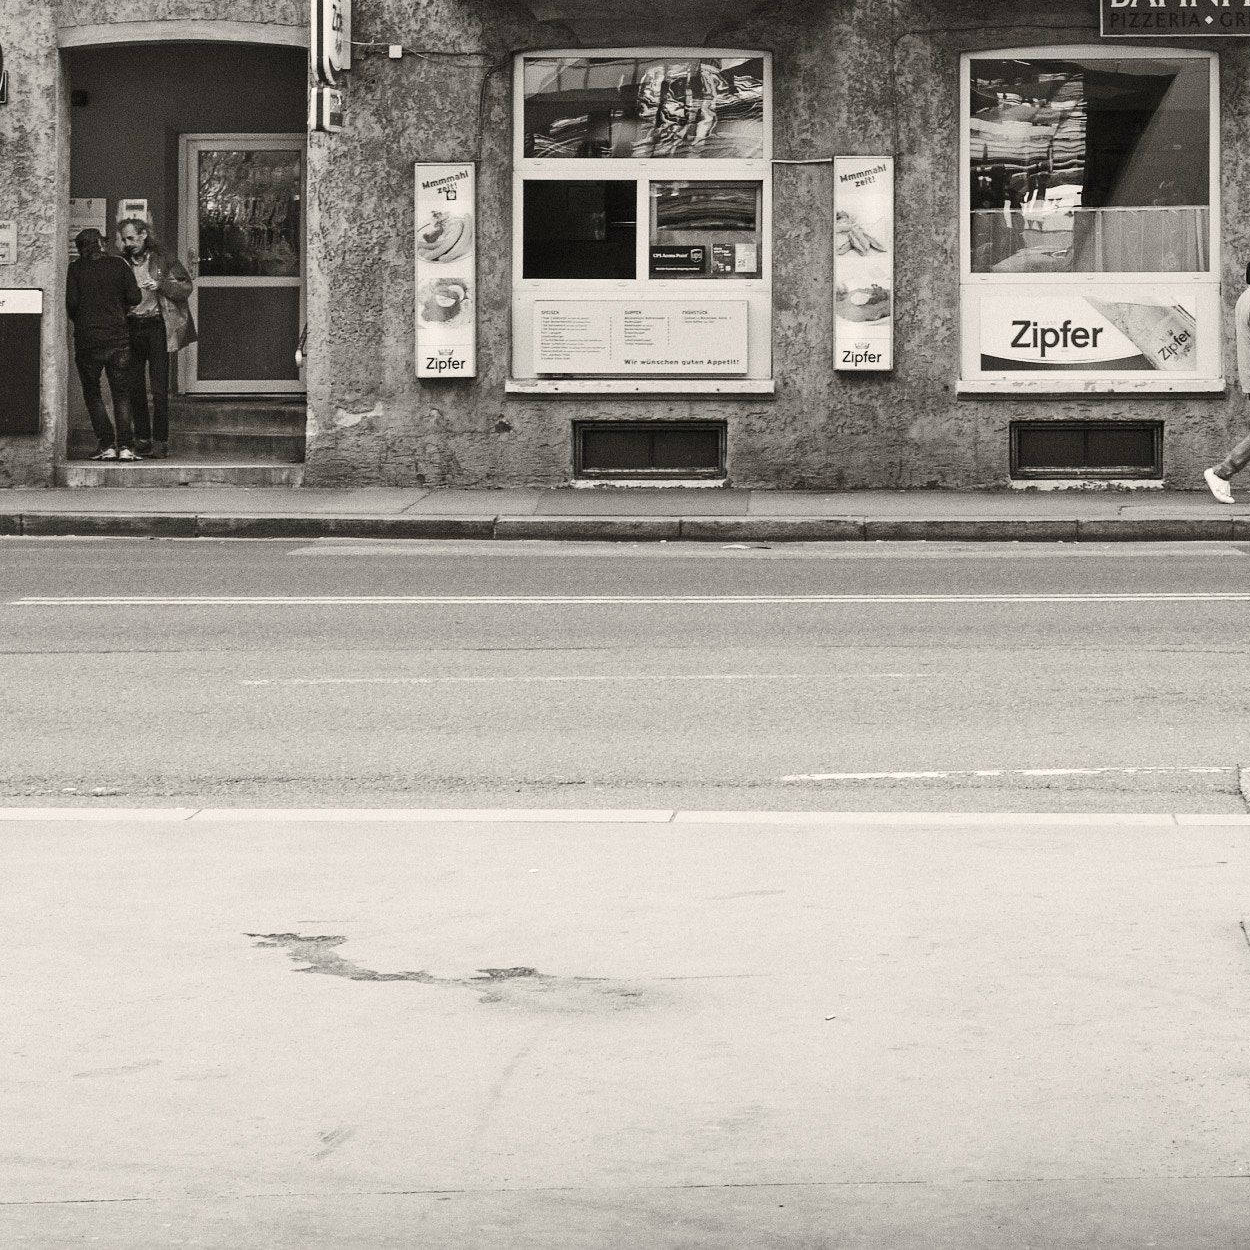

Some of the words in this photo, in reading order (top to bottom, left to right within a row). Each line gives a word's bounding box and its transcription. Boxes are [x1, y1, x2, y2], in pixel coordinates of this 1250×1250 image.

[1110, 12, 1201, 29] PIZZERIA
[437, 182, 458, 194] zeit!
[855, 176, 876, 188] zeit!
[1010, 320, 1103, 357] Zipfer
[426, 357, 466, 373] Zipfer
[842, 350, 882, 366] Zipfer
